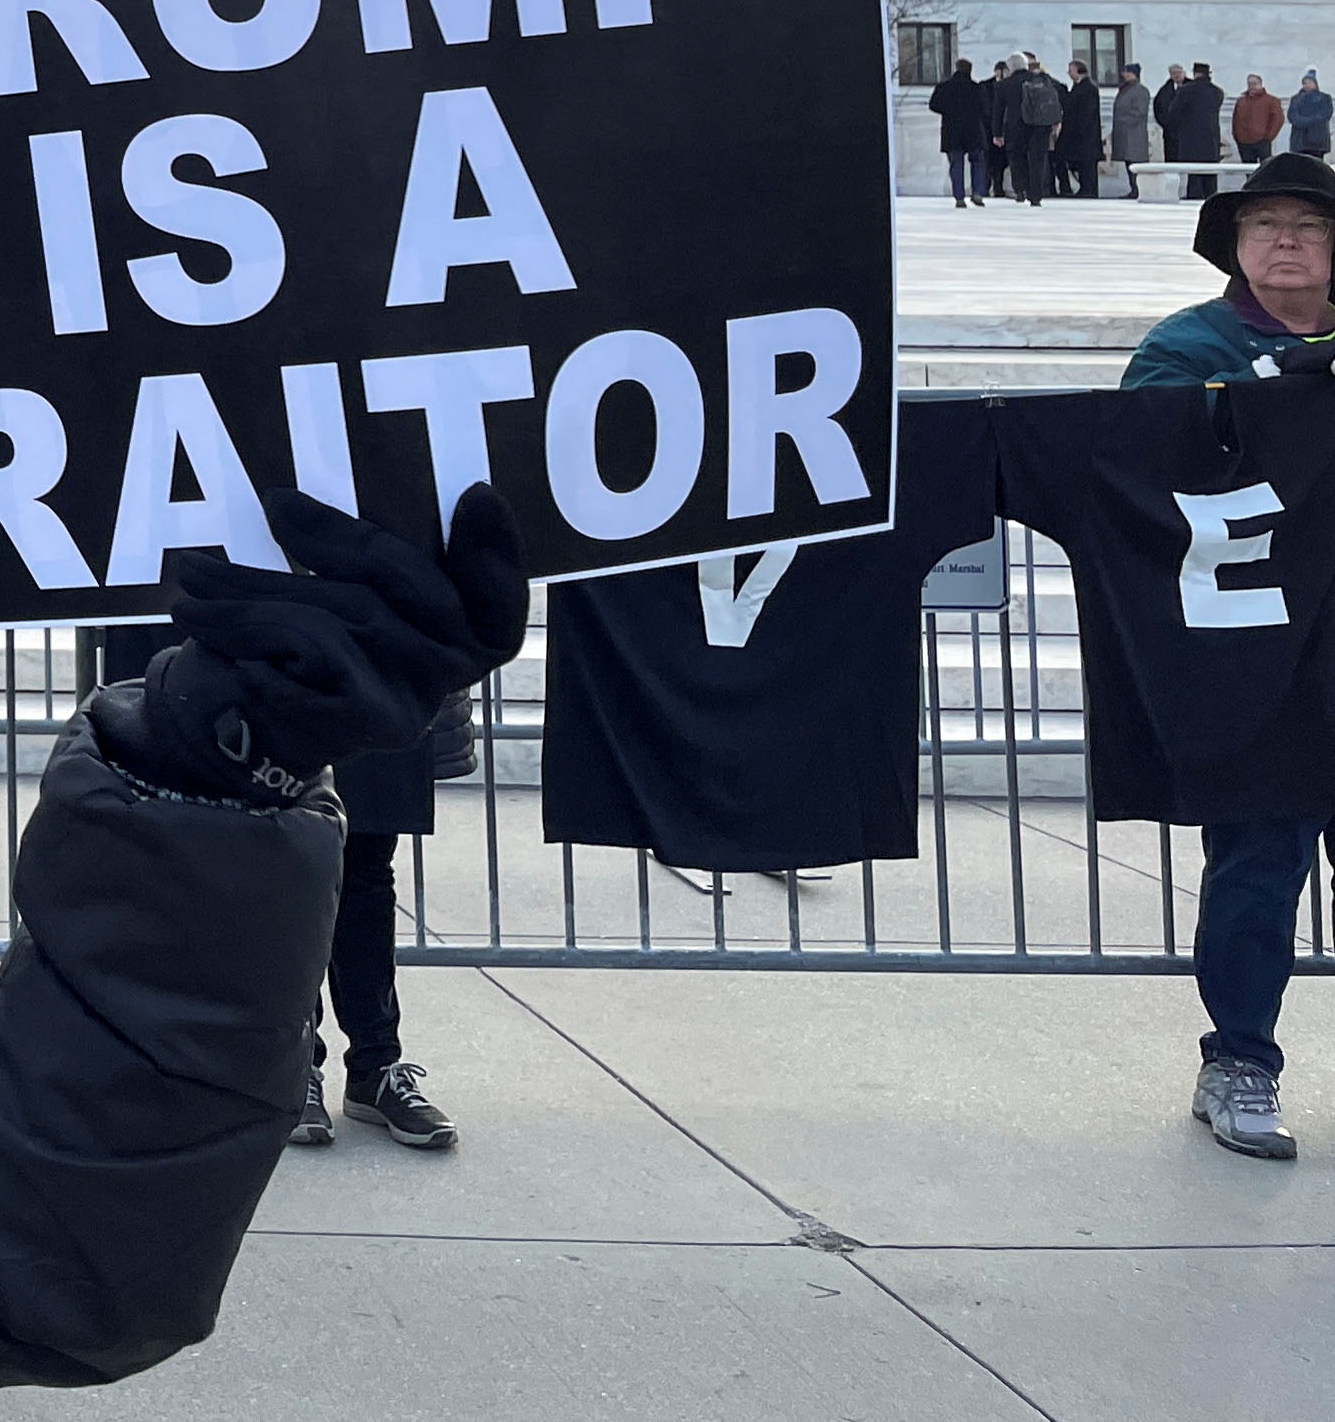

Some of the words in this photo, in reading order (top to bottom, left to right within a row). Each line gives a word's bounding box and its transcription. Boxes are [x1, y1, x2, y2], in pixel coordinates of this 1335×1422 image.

[28, 113, 286, 336] IS
[385, 86, 578, 307] A
[698, 542, 800, 648] V
[949, 563, 985, 574] Marshal
[1172, 481, 1290, 629] E
